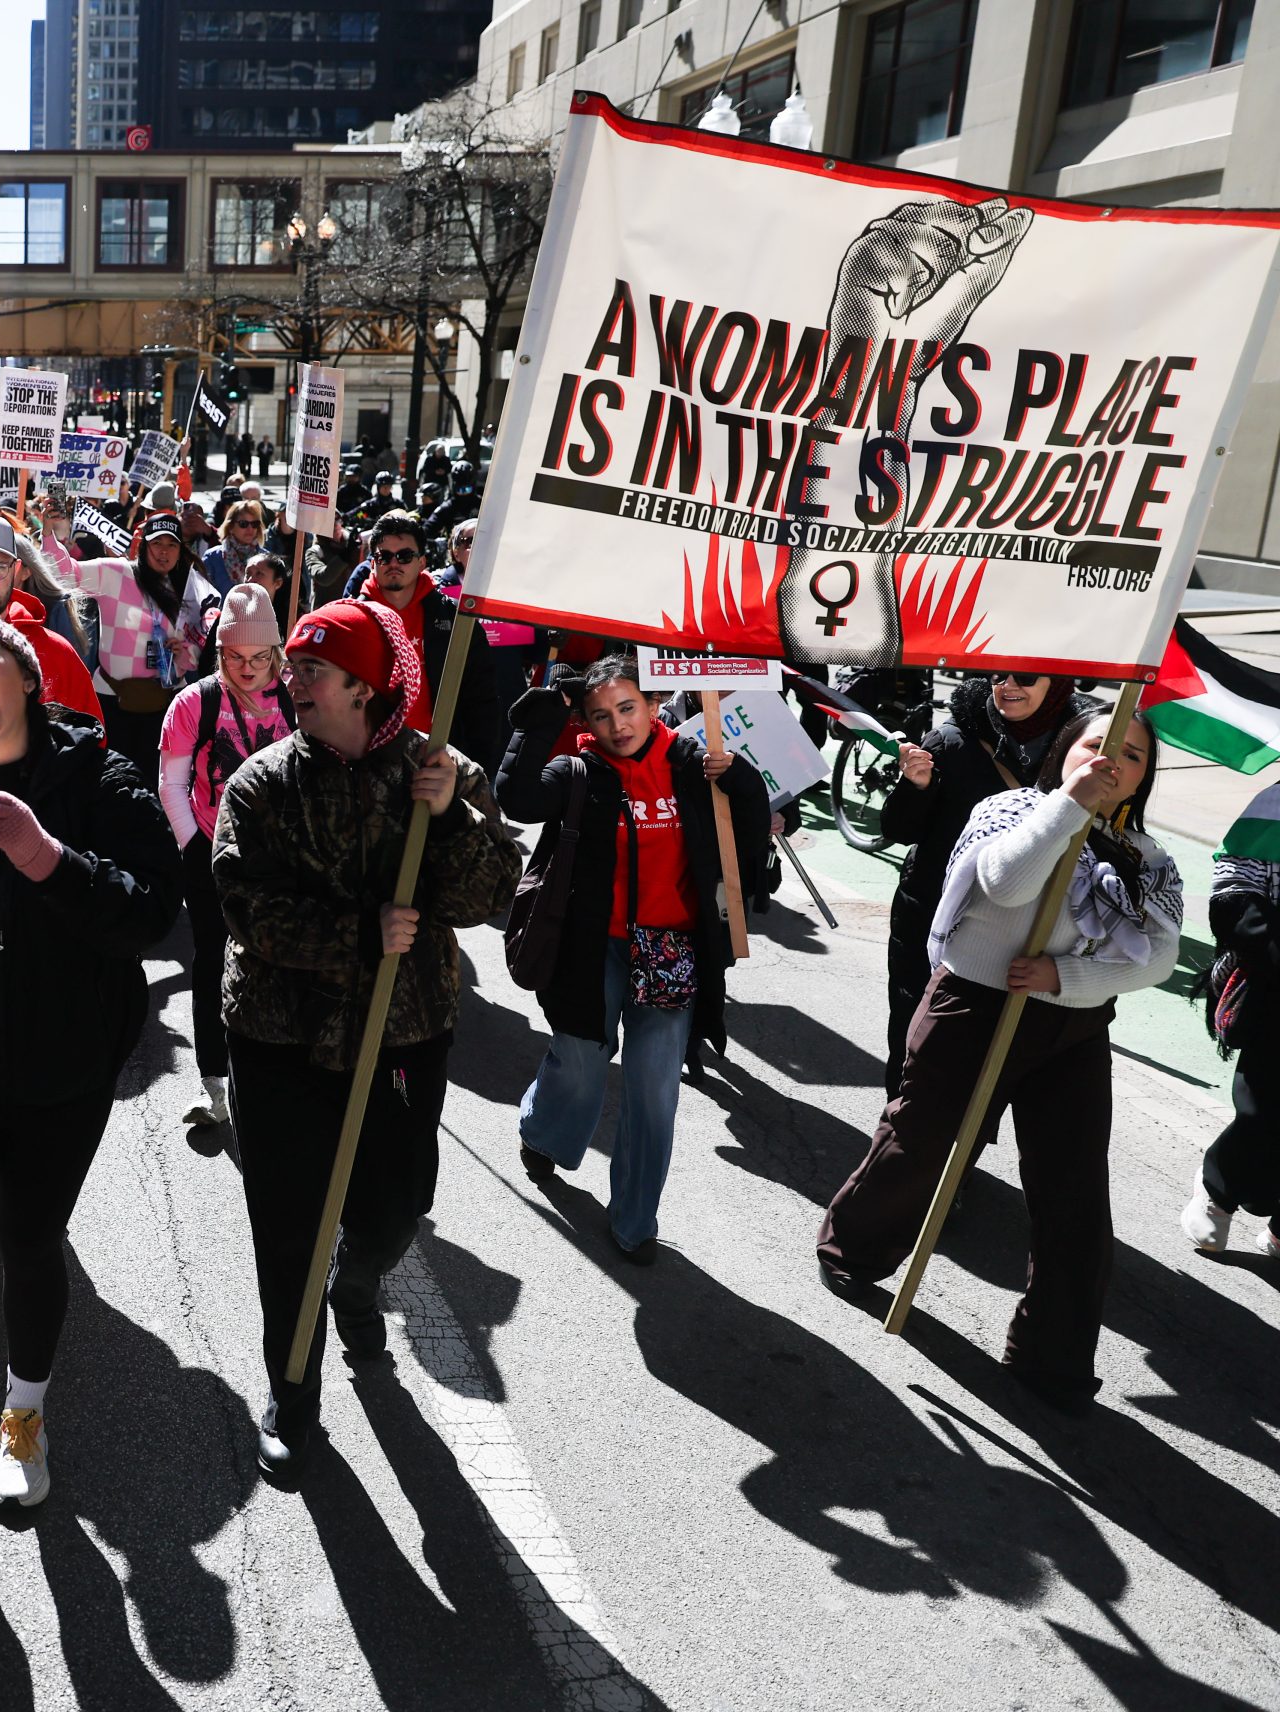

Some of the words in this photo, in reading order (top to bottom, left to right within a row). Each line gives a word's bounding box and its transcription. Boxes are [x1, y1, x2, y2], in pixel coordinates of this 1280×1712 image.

[585, 278, 637, 377] A
[650, 294, 991, 437] WOMAN'S
[1003, 349, 1197, 447] PLACE
[6, 376, 59, 385] INTERNATIONAL
[6, 382, 40, 390] WOMEN'S
[6, 387, 35, 404] STOP
[37, 389, 58, 406] THE
[3, 402, 56, 416] DEPORTATIONS
[2, 424, 19, 435] KEEP
[21, 426, 55, 439] FAMILIES
[310, 420, 332, 432] LAS
[1, 435, 52, 453] TOGETHER
[164, 440, 177, 450] THE
[154, 450, 170, 464] WON
[541, 372, 625, 476] IS
[630, 390, 701, 495] IN
[716, 411, 842, 518] THE
[855, 435, 1187, 541] STRUGGLE
[78, 507, 119, 539] FUCK
[152, 521, 178, 533] RESIST
[619, 491, 728, 534] FREEDOM
[728, 513, 779, 543] ROAD
[787, 523, 919, 554] SOCIALIST
[914, 533, 1075, 564] ORGANIZATION
[1067, 566, 1154, 593] FRSO.ORG
[653, 662, 701, 675] FRSO
